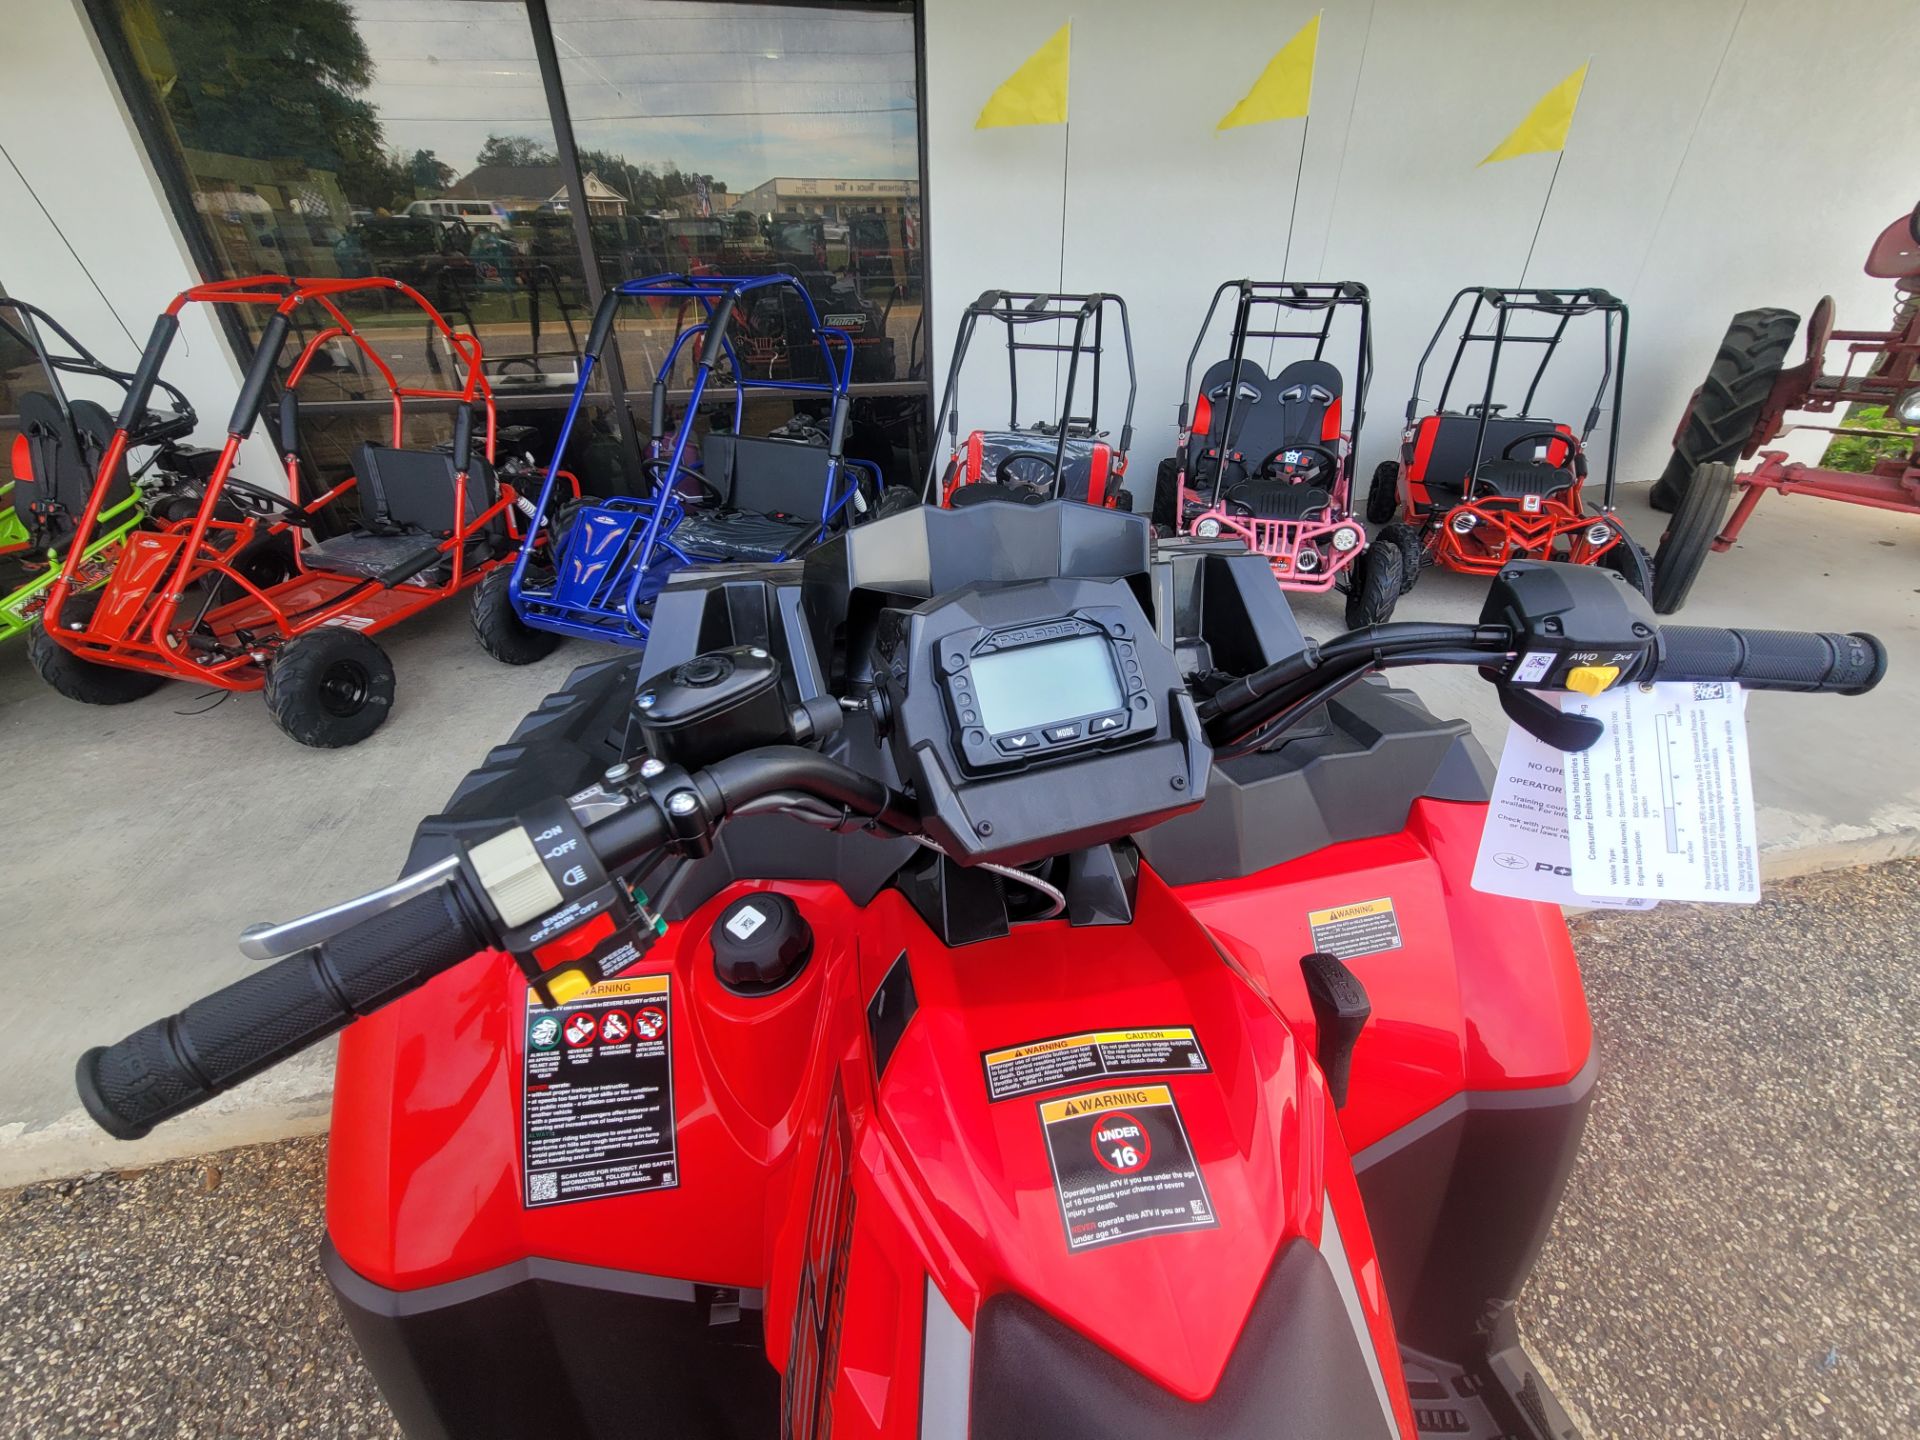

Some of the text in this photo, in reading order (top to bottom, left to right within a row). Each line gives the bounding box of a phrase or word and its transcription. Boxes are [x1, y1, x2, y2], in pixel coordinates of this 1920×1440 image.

[998, 623, 1076, 646] POLARIS
[1056, 727, 1075, 738] MODE
[1527, 761, 1542, 770] NO
[1508, 776, 1562, 793] OPERATOR
[1570, 757, 1581, 819] Polaris Industries
[1512, 795, 1544, 807] Training
[1583, 782, 1593, 819] Emissions
[1496, 813, 1521, 823] Check
[1540, 824, 1558, 833] your
[1519, 824, 1537, 832] local
[1620, 819, 1629, 844] Name(s):
[552, 838, 578, 857] OFF
[1585, 822, 1595, 859] Consumer
[1608, 848, 1617, 884] Vehicle Type:
[1622, 865, 1630, 885] Vehicle
[1635, 866, 1645, 886] Engine
[542, 902, 581, 927] ENGINE
[1337, 904, 1373, 917] WARNING
[602, 947, 637, 971] REVERSE
[602, 952, 642, 976] OVERRIDE
[1024, 1041, 1067, 1054] WARNING
[538, 1097, 556, 1105] speeds
[630, 1085, 658, 1094] conditions
[552, 1088, 569, 1096] proper
[571, 1086, 591, 1094] training
[600, 1082, 628, 1090] instruction
[1078, 1090, 1147, 1111] WARNING
[543, 1137, 560, 1145] proper
[562, 1134, 577, 1142] riding
[579, 1130, 608, 1140] techniques
[617, 1127, 631, 1135] avoid
[633, 1125, 651, 1133] vehicle
[1097, 1125, 1139, 1141] UNDER
[531, 1158, 547, 1166] affect
[548, 1155, 572, 1164] handling
[585, 1151, 604, 1159] control
[1110, 1146, 1138, 1167] 16
[561, 1172, 576, 1180] SCAN
[578, 1170, 594, 1178] CODE
[609, 1164, 637, 1173] PRODUCT
[652, 1159, 673, 1167] SAFETY
[561, 1175, 603, 1187] INFORMATION.
[605, 1172, 629, 1180] FOLLOW
[561, 1181, 604, 1193] INSTRUCTIONS
[606, 1179, 617, 1187] AND
[619, 1175, 651, 1185] WARNINGS.
[1062, 1185, 1096, 1199] Operating
[1095, 1182, 1109, 1191] this
[1109, 1179, 1122, 1187] ATV
[1128, 1177, 1142, 1185] you
[1153, 1172, 1171, 1181] under
[1171, 1171, 1182, 1179] the
[1183, 1170, 1195, 1179] age
[1064, 1199, 1073, 1207] of
[1073, 1197, 1082, 1206] 16
[1082, 1191, 1115, 1203] increases
[1115, 1188, 1131, 1198] your
[1131, 1183, 1155, 1194] chance
[1163, 1180, 1185, 1190] severe
[1067, 1207, 1086, 1218] injury
[1095, 1201, 1118, 1211] death.
[1070, 1221, 1096, 1233] NEVER
[1096, 1215, 1125, 1228] operate
[1125, 1211, 1139, 1221] this
[1139, 1209, 1154, 1218] ATV
[1160, 1207, 1174, 1216] you
[1072, 1226, 1121, 1243] under age 16.
